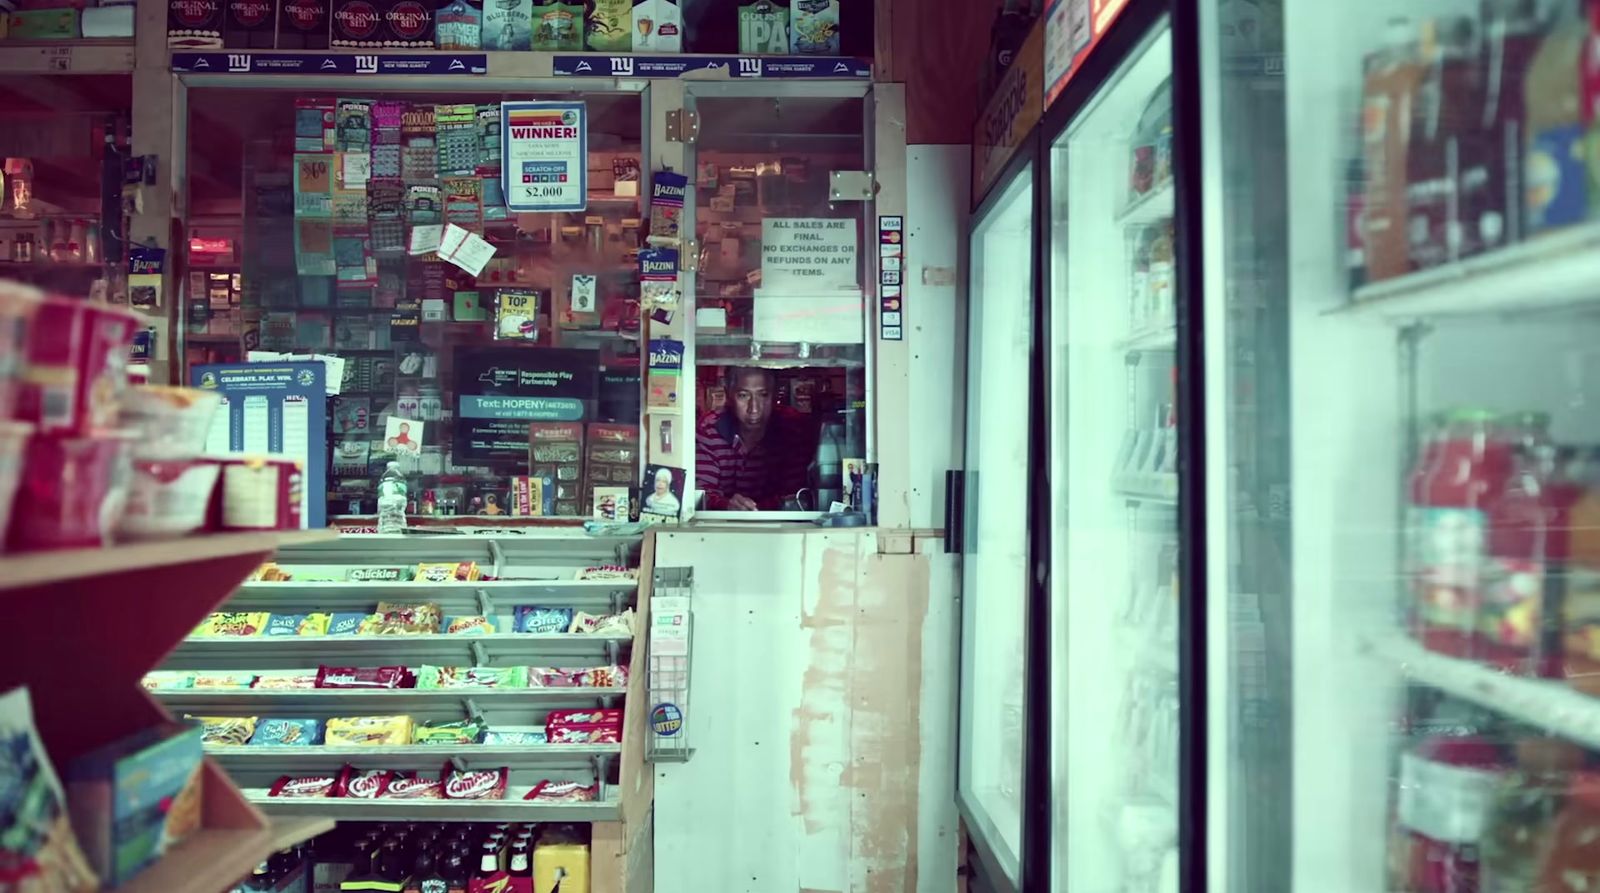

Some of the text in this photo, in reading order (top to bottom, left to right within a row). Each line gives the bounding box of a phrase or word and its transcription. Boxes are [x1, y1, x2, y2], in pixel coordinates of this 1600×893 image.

[334, 11, 381, 21] ORIGINAL
[385, 11, 432, 21] ORIGINAL
[486, 10, 529, 22] BLUEBERRY
[438, 22, 479, 34] SUMMER
[455, 34, 479, 47] TIME
[741, 21, 788, 54] IPA
[228, 54, 251, 72] ny
[355, 55, 378, 73] ny
[610, 57, 633, 75] ny
[738, 58, 762, 76] ny
[479, 110, 500, 119] POKE
[511, 127, 577, 139] WINNER!
[654, 183, 685, 197] BAZZINI
[773, 221, 846, 229] ALL SALES ARE
[883, 220, 900, 228] VISA
[793, 233, 824, 241] FINAL.
[780, 245, 839, 253] EXCHANGES
[643, 260, 674, 273] BAZZINI
[507, 296, 528, 307] TOP
[649, 351, 681, 366] BAZZINI
[521, 371, 573, 380] Responsible Play
[521, 378, 557, 386] Partnership
[477, 399, 501, 408] Text:
[503, 400, 545, 409] HOPENY
[351, 568, 398, 580] Chuckles
[337, 617, 355, 627] JOLLY
[421, 879, 446, 888] MAGIC
